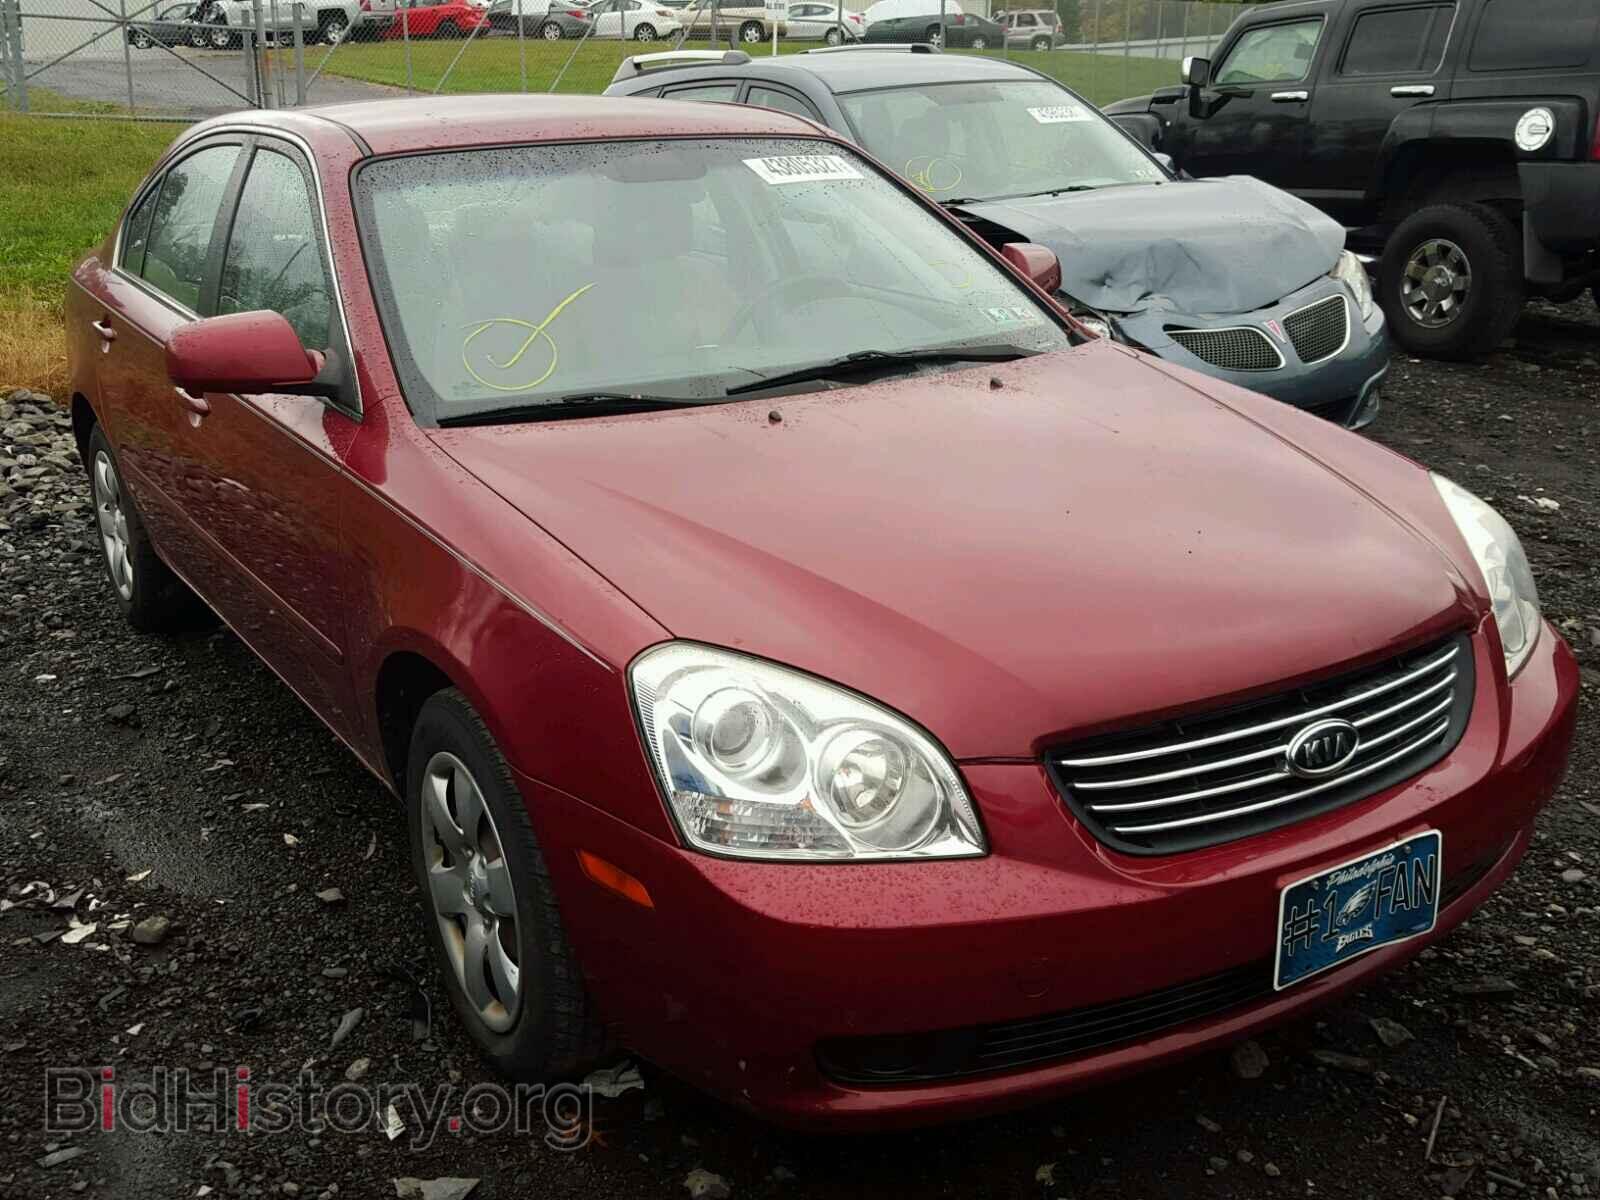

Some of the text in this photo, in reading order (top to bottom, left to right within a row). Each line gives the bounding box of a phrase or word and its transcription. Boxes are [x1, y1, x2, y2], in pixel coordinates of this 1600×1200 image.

[1303, 731, 1350, 767] KIA
[1283, 853, 1435, 957] #1 FAN
[1335, 922, 1374, 953] EAGLES
